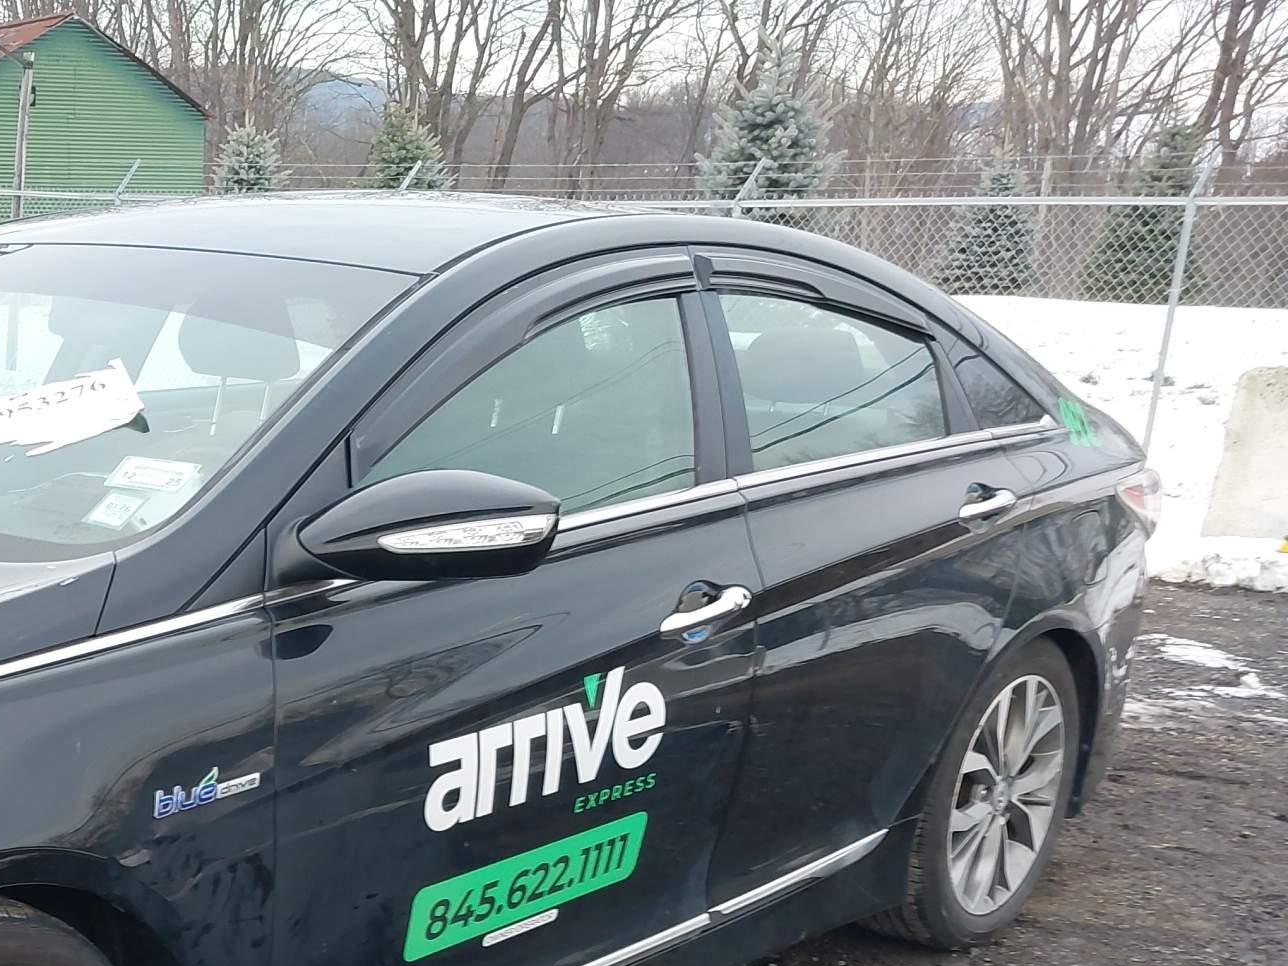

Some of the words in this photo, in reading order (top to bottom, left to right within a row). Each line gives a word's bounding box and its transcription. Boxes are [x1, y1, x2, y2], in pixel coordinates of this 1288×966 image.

[423, 666, 667, 832] arrive
[153, 781, 219, 819] blue
[219, 777, 257, 796] drive
[574, 773, 657, 813] EXPRESS
[426, 833, 630, 941] 845.622.1111
